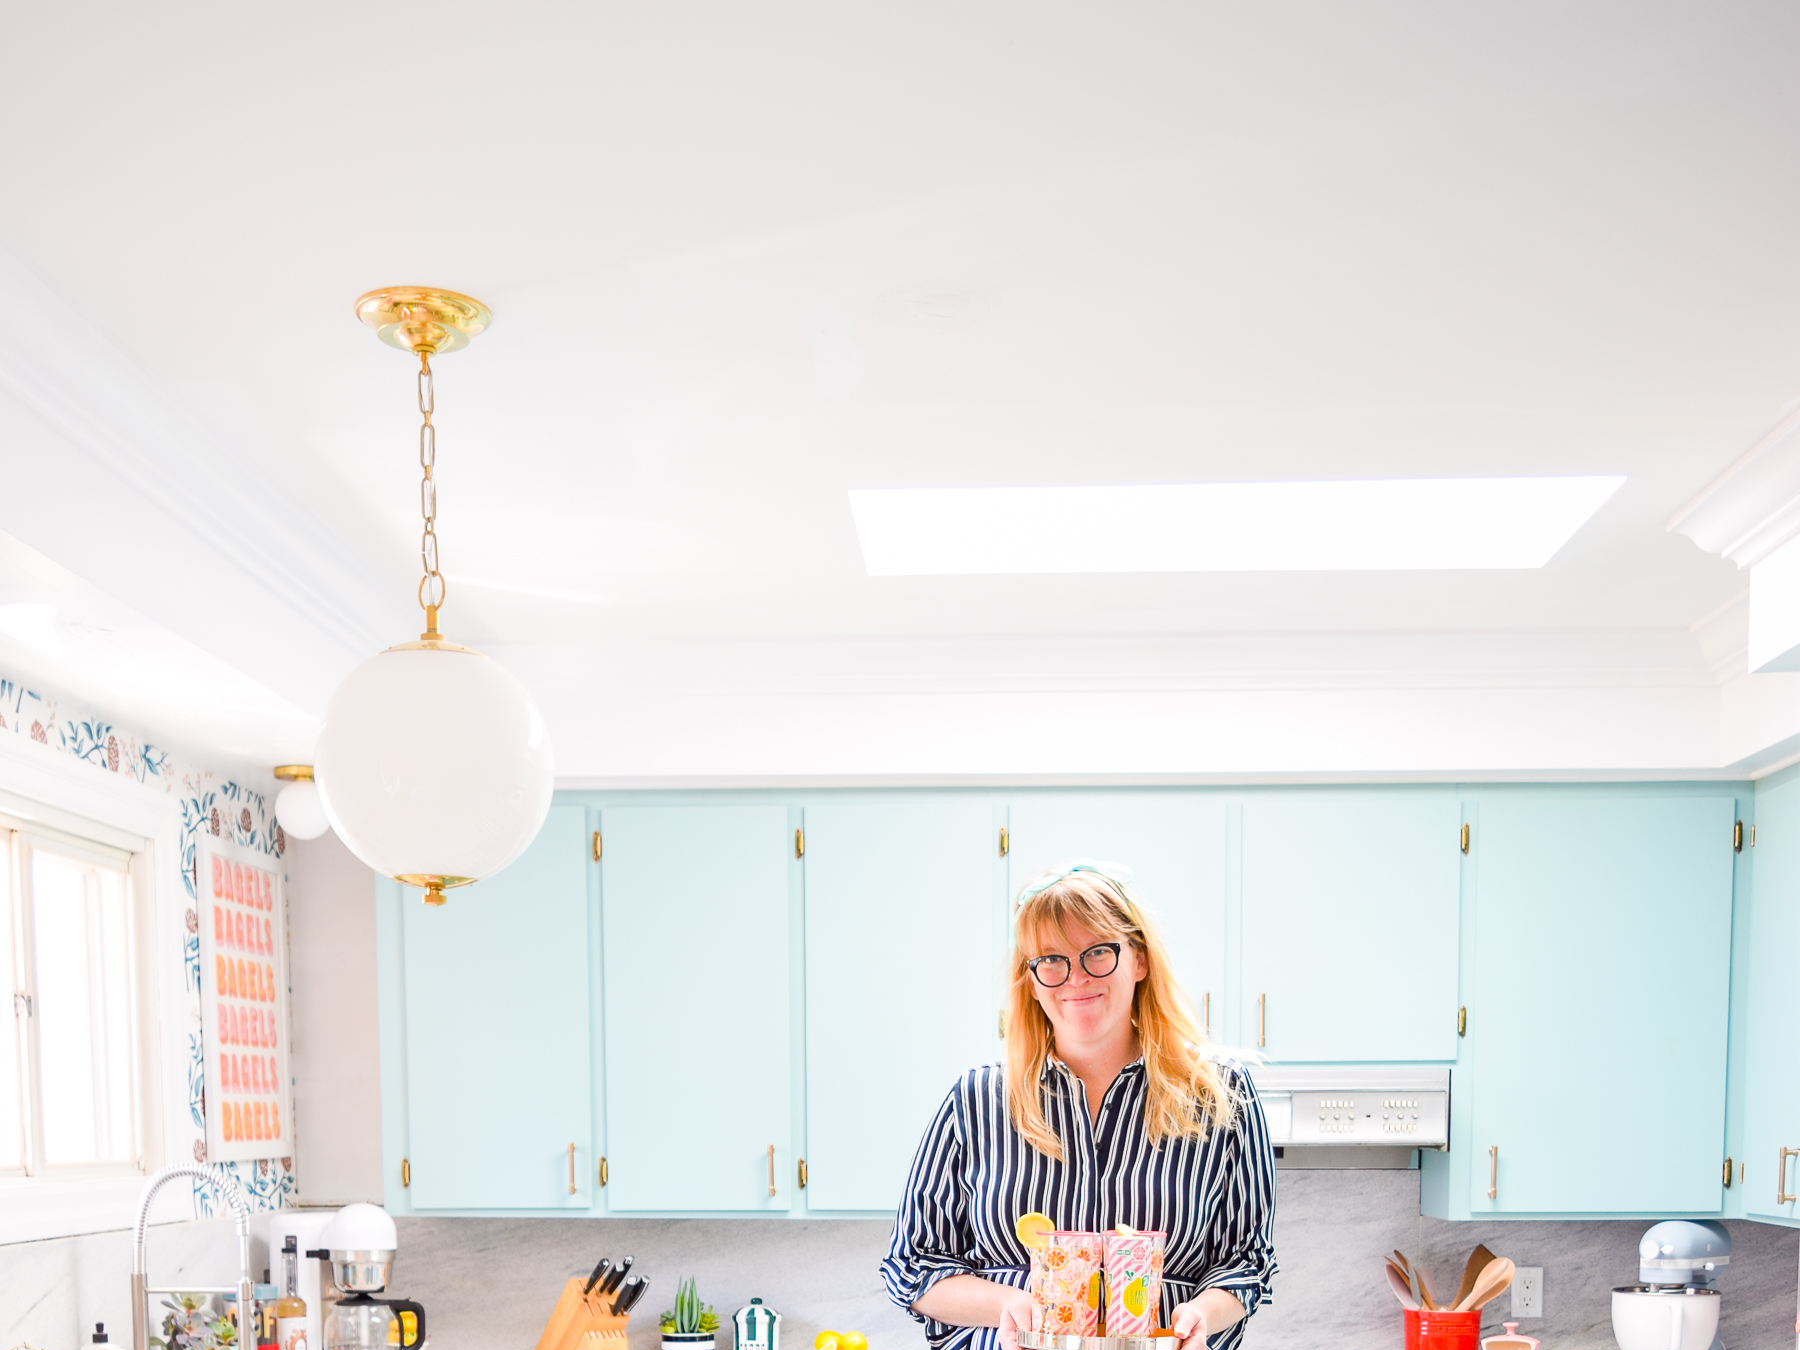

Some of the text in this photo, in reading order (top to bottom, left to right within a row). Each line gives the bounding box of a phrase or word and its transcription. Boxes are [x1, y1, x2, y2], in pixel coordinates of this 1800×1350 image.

[211, 856, 272, 912] BAGELS
[214, 905, 274, 958] BAGELS
[215, 954, 275, 1003] BAGELS
[217, 1003, 278, 1049] BAGELS
[220, 1052, 279, 1094] BAGELS
[222, 1100, 281, 1143] BAGELS
